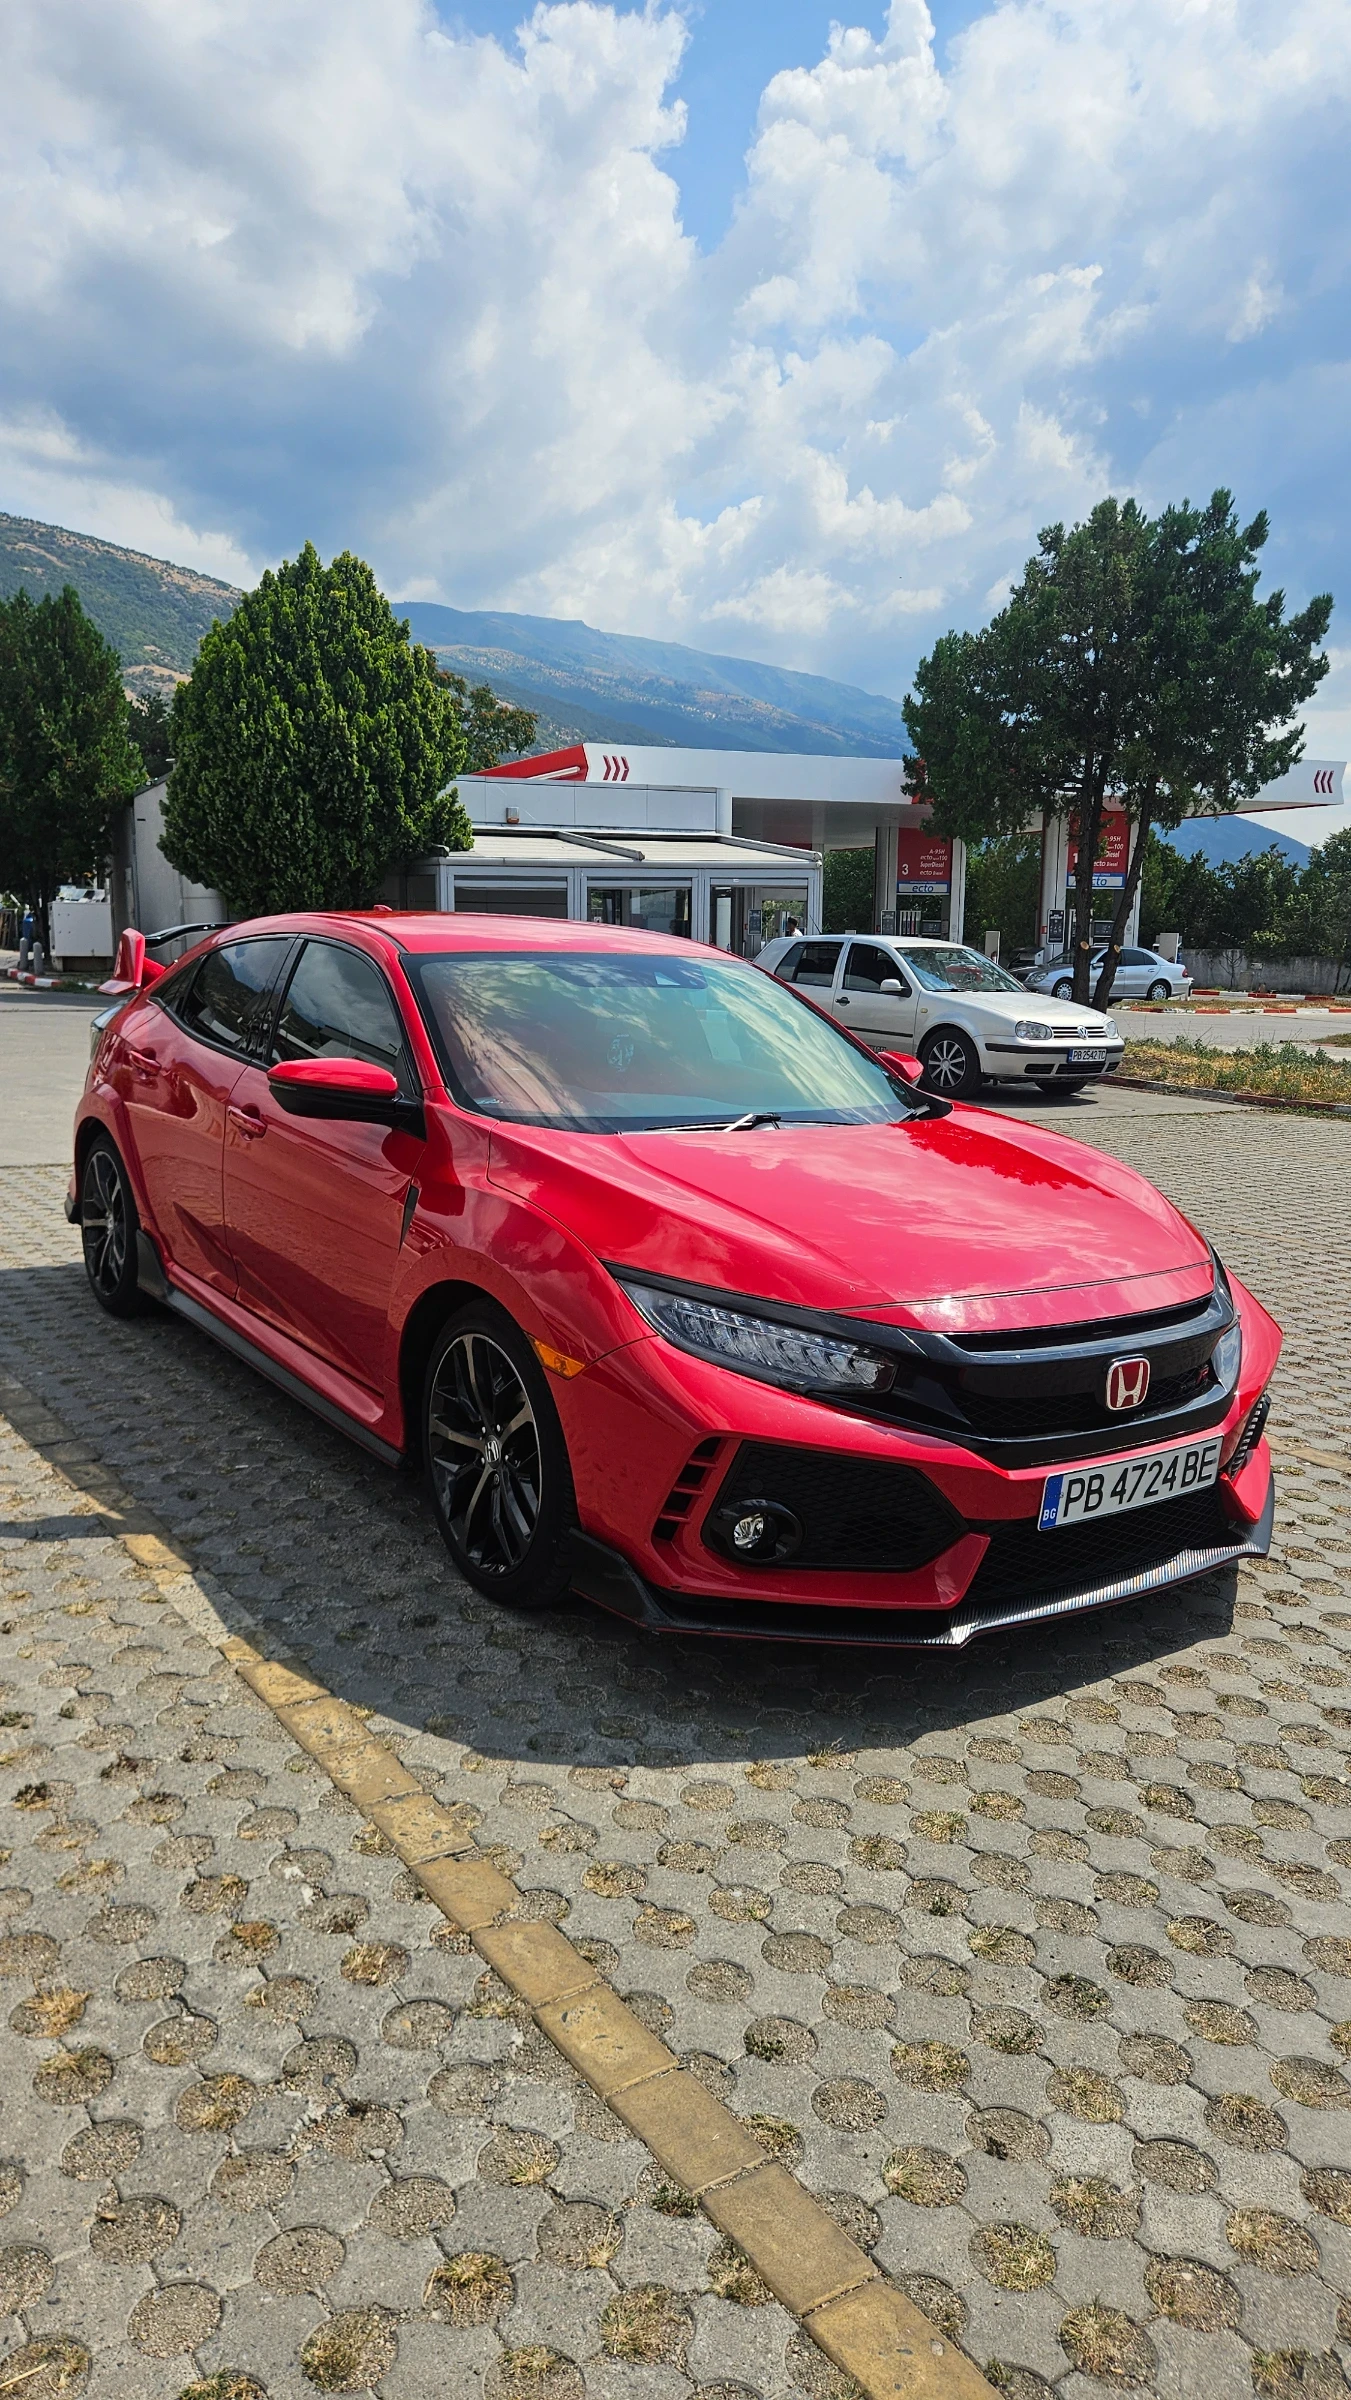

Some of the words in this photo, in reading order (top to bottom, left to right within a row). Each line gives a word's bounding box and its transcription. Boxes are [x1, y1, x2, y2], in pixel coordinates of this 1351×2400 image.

[1073, 852, 1078, 864] 1
[902, 864, 909, 875] 3
[912, 884, 934, 892] ecto
[1074, 1050, 1082, 1060] PB
[1063, 1474, 1105, 1518] PB
[1110, 1455, 1179, 1505] 4724
[1180, 1443, 1218, 1489] BE
[1042, 1508, 1057, 1521] BG
